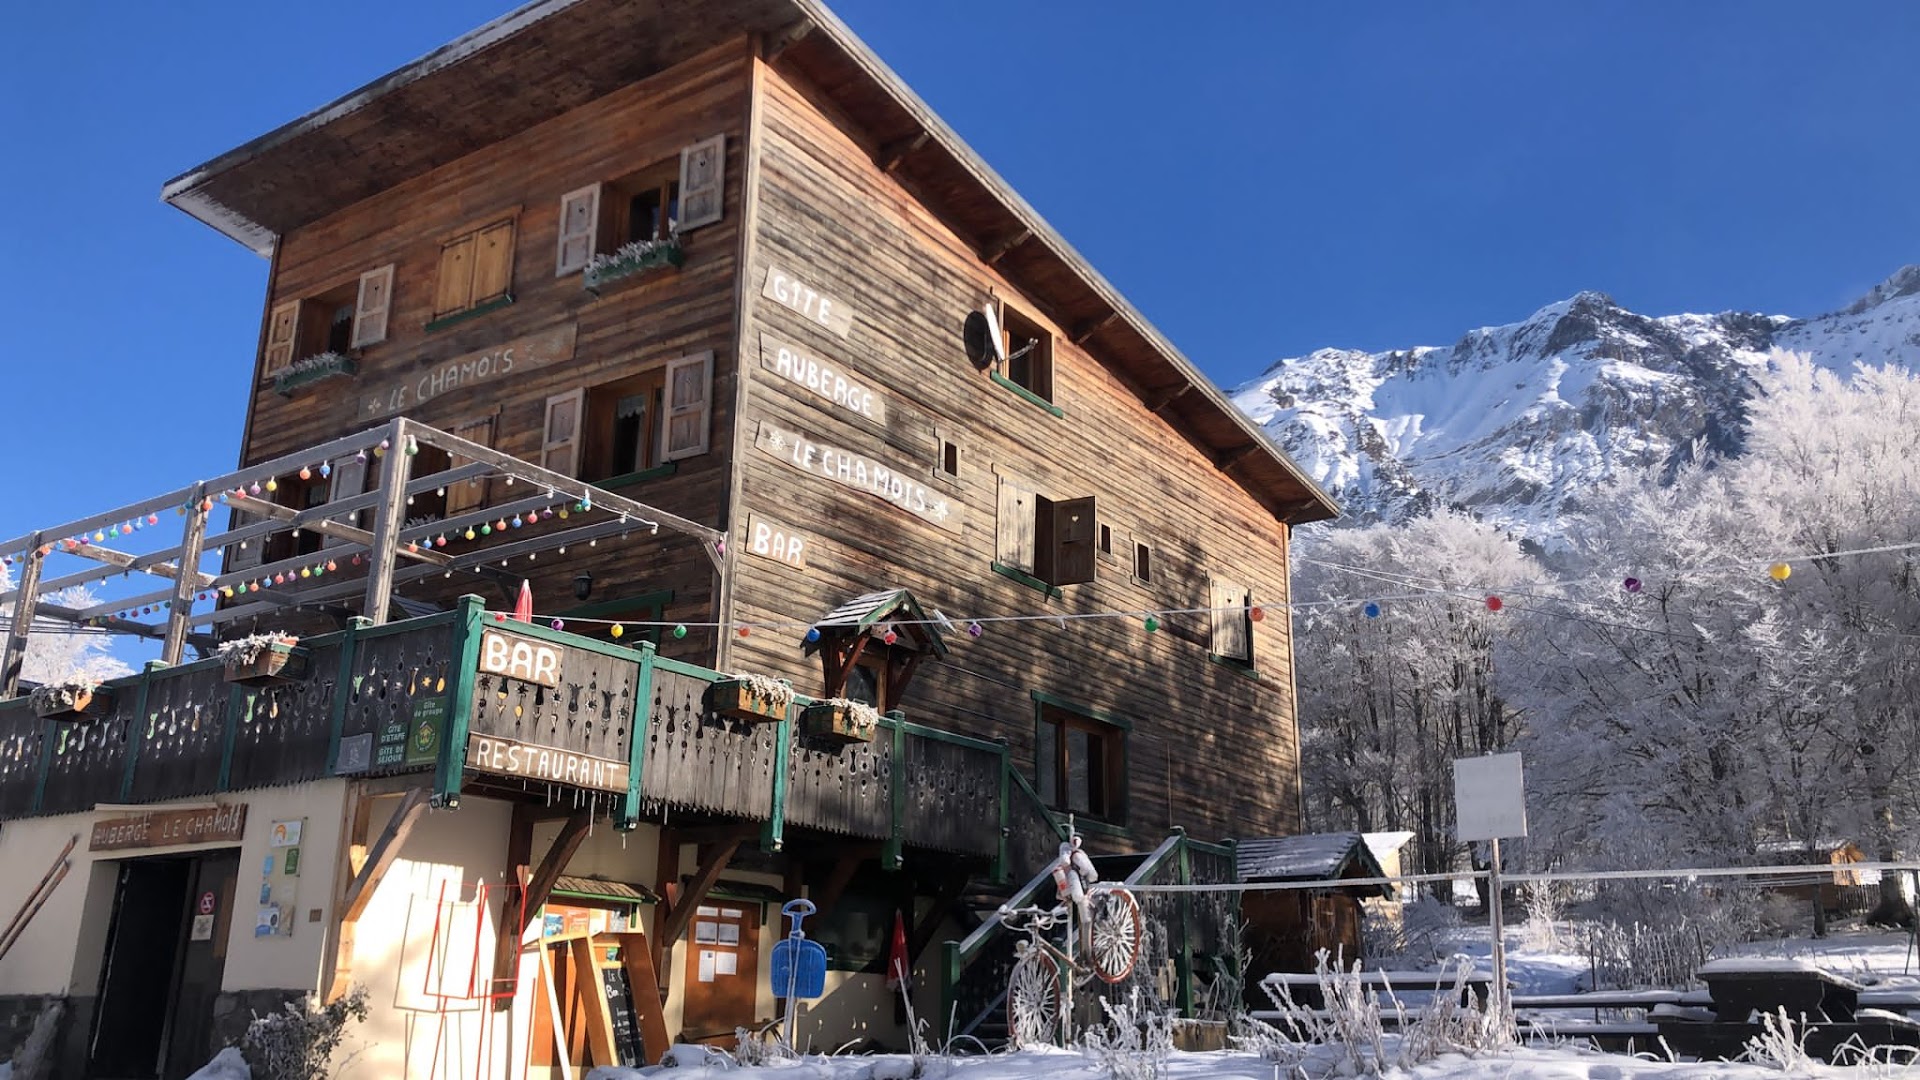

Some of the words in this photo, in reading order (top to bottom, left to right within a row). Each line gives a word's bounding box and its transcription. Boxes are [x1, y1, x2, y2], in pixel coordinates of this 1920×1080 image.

[389, 386, 407, 410] LE
[416, 349, 514, 400] CHAMOIS
[777, 347, 873, 419] AUBERGE
[792, 440, 816, 470] LE
[822, 450, 927, 513] CHAMOIS
[753, 522, 804, 565] BAR
[486, 635, 557, 684] BAR
[476, 739, 620, 789] RESTAURANT
[92, 819, 149, 845] AUBERGE
[162, 819, 181, 838] LE
